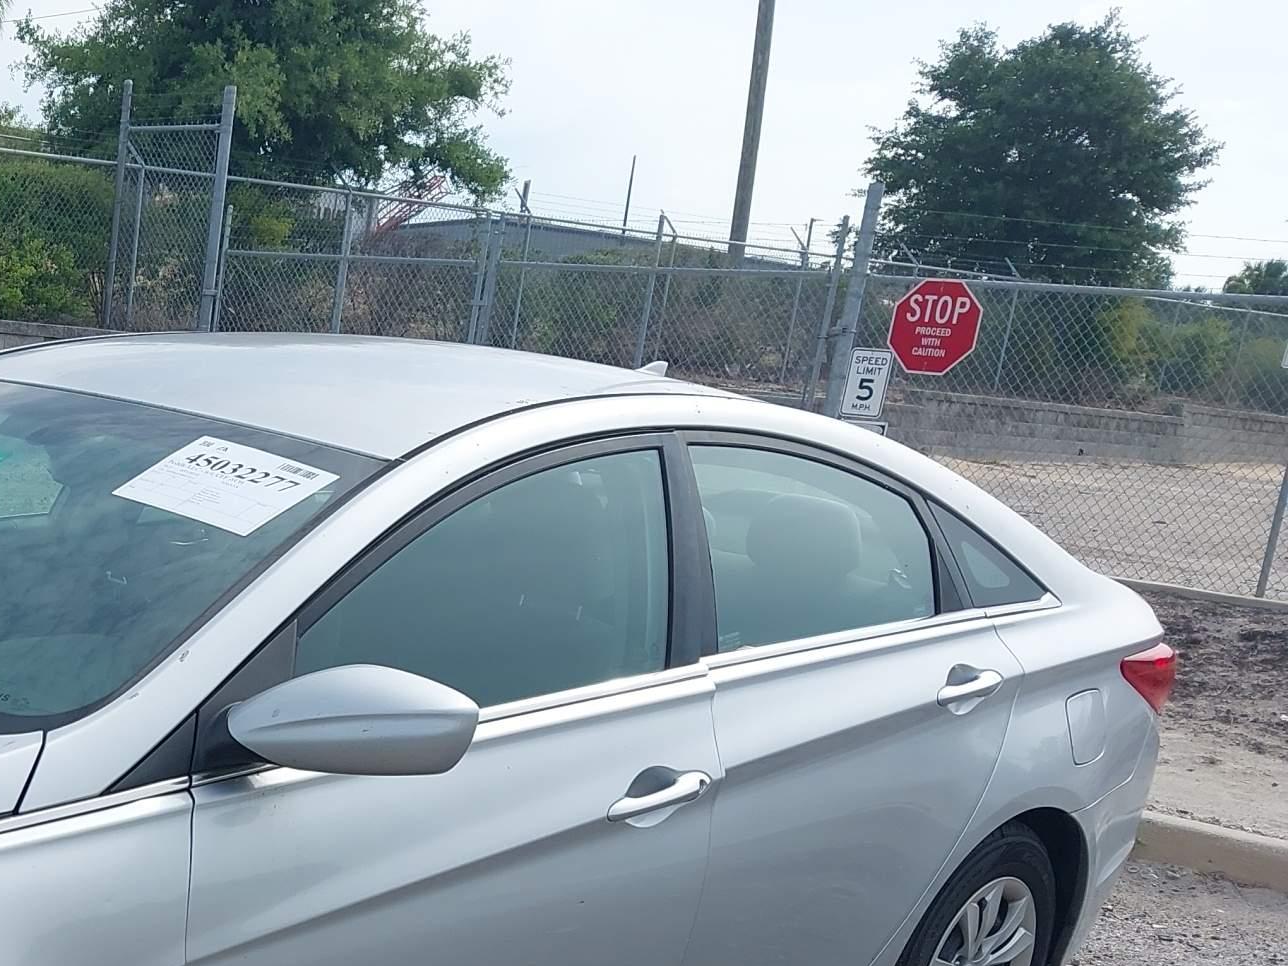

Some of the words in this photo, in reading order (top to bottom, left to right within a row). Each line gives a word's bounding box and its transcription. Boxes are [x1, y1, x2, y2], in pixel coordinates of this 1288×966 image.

[906, 294, 971, 324] STOP
[915, 326, 952, 337] PROCEED
[921, 337, 941, 347] WITH
[912, 347, 946, 358] CAUTION
[854, 355, 888, 366] SPEED
[856, 366, 884, 376] LIMIT
[855, 378, 875, 401] 5
[185, 453, 300, 492] 45032277
